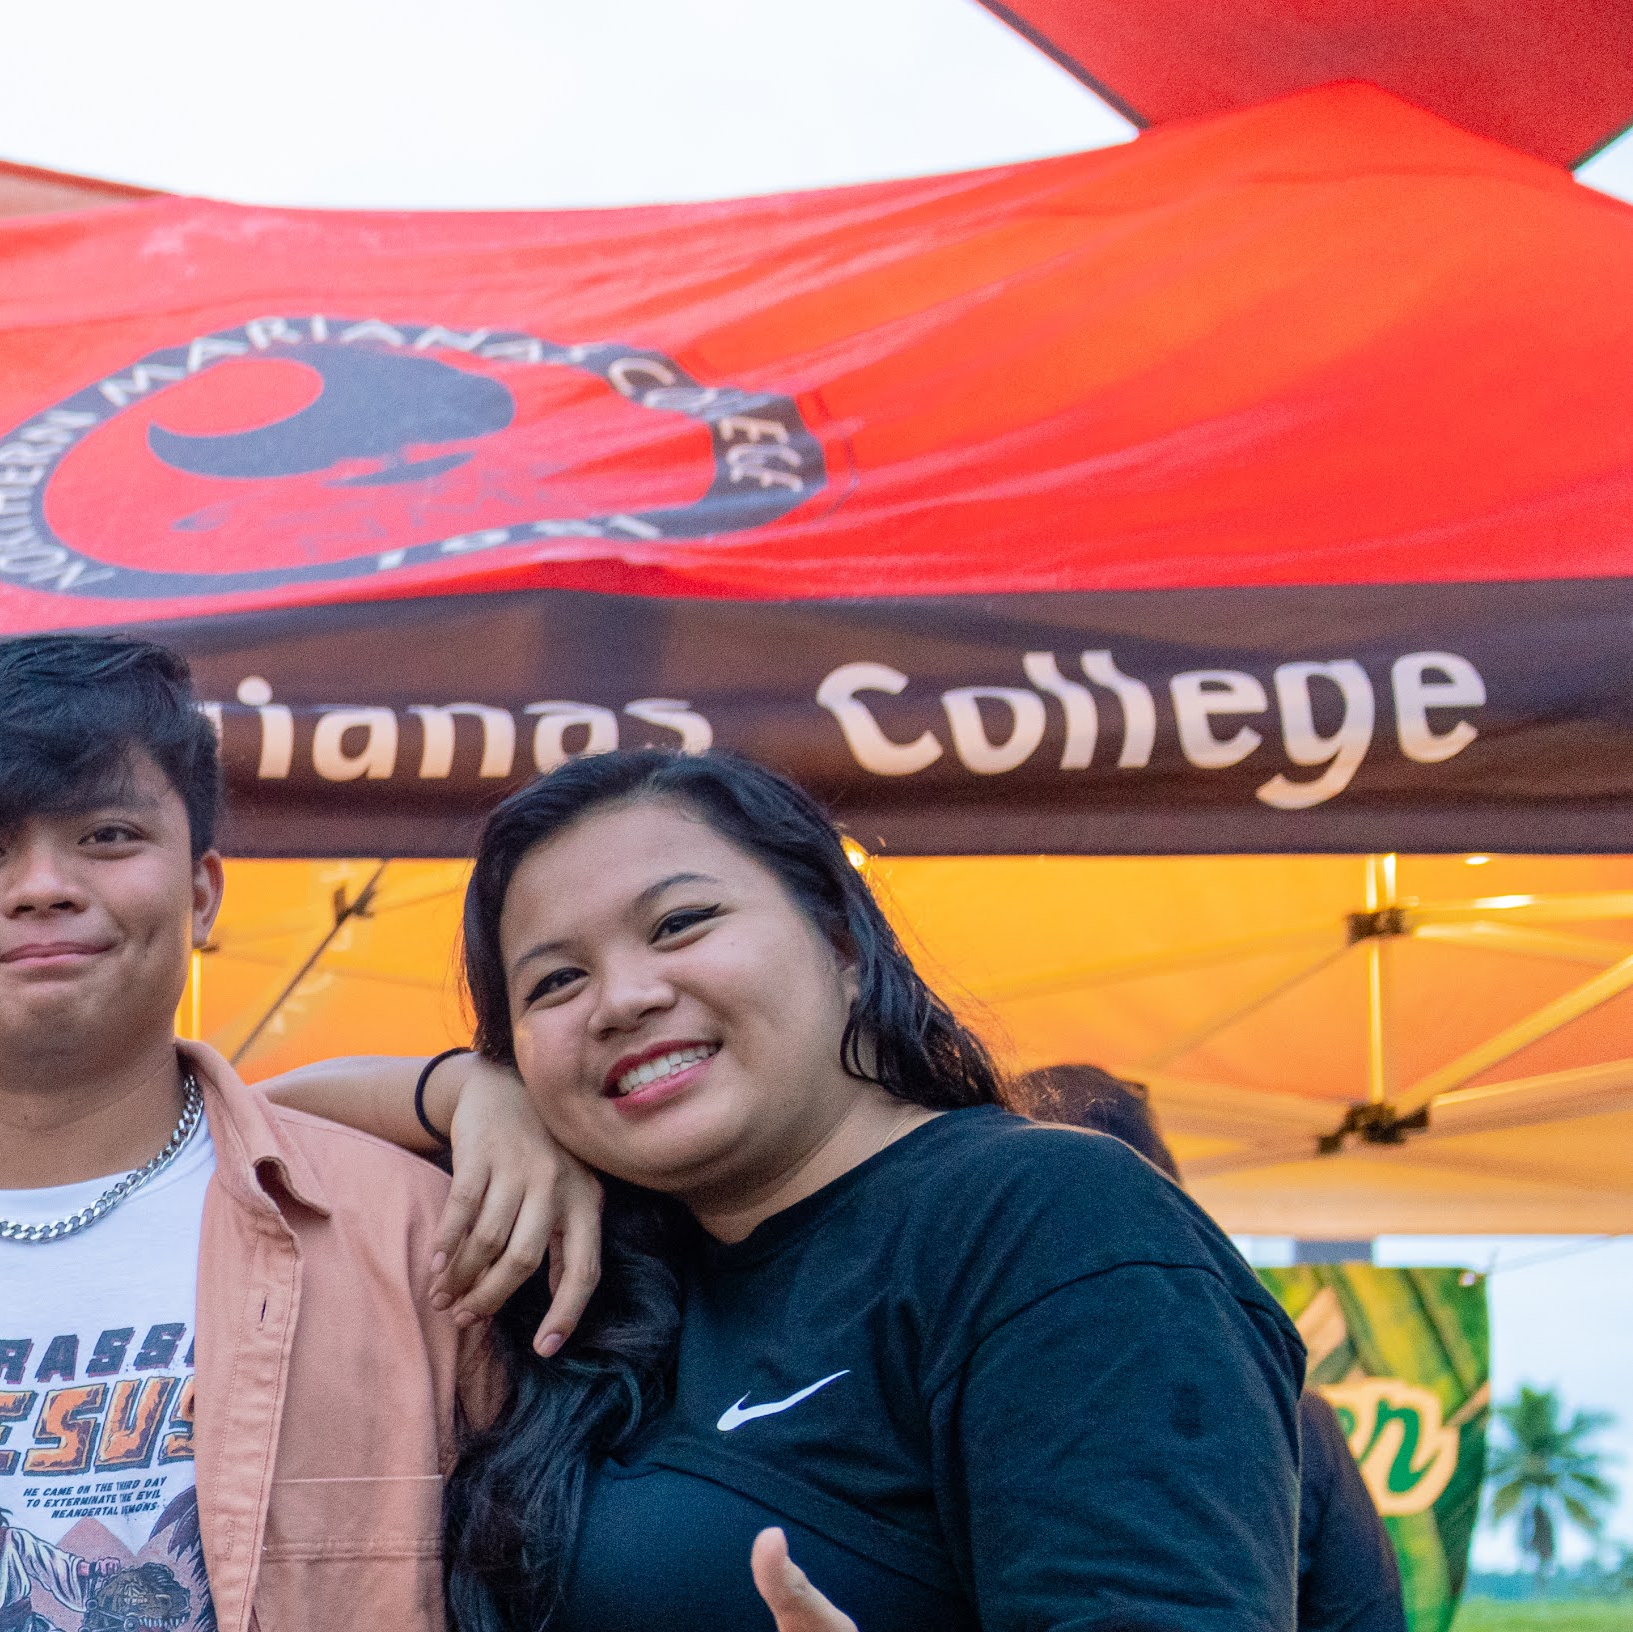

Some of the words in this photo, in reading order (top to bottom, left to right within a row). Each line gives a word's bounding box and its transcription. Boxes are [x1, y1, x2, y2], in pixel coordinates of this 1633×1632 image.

[202, 676, 714, 781] ianas
[816, 649, 1488, 810] College
[23, 1487, 40, 1497] HE
[42, 1486, 74, 1496] CAME
[77, 1484, 91, 1495] ON
[95, 1482, 114, 1493] THE
[116, 1479, 141, 1491] THIRD
[143, 1476, 168, 1488] DAY
[26, 1499, 41, 1508] TO
[43, 1494, 117, 1508] EXTERMINATE
[119, 1491, 134, 1503] THE
[136, 1489, 162, 1501] EVIL
[51, 1505, 119, 1519] NEANDERTAL
